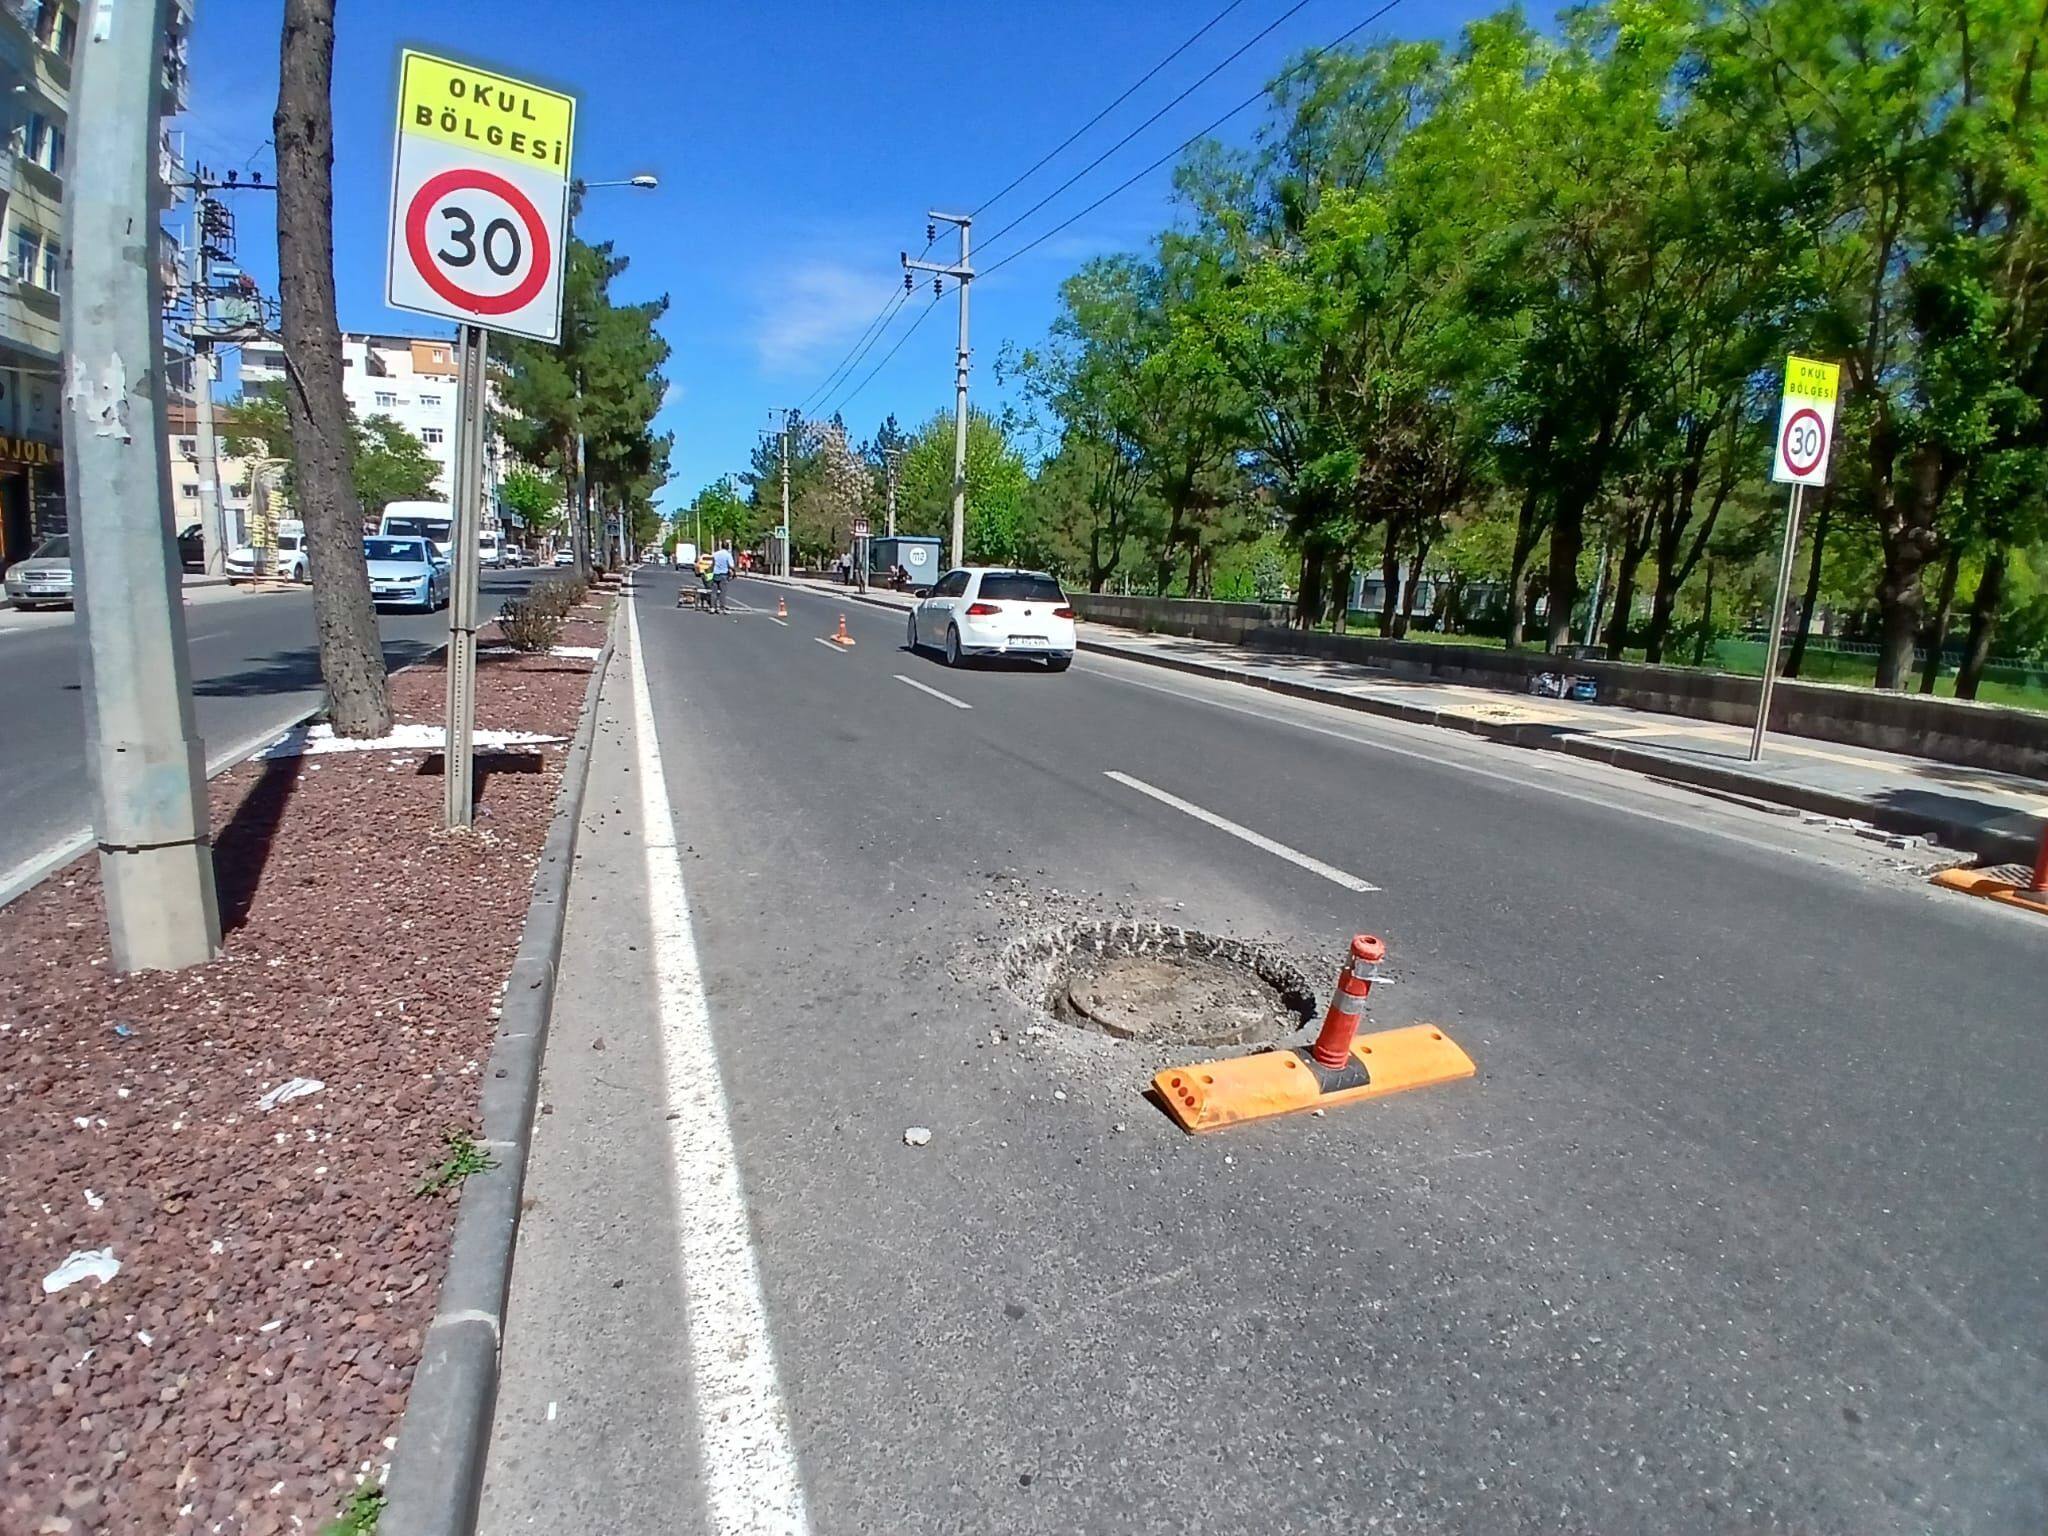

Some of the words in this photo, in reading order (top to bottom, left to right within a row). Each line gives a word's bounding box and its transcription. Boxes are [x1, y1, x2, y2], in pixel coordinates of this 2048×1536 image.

[449, 78, 536, 121] OKUL
[415, 104, 562, 165] BÖLGESİ
[437, 207, 522, 276] 30
[1800, 367, 1827, 380] OKUL
[1790, 426, 1817, 457] 30
